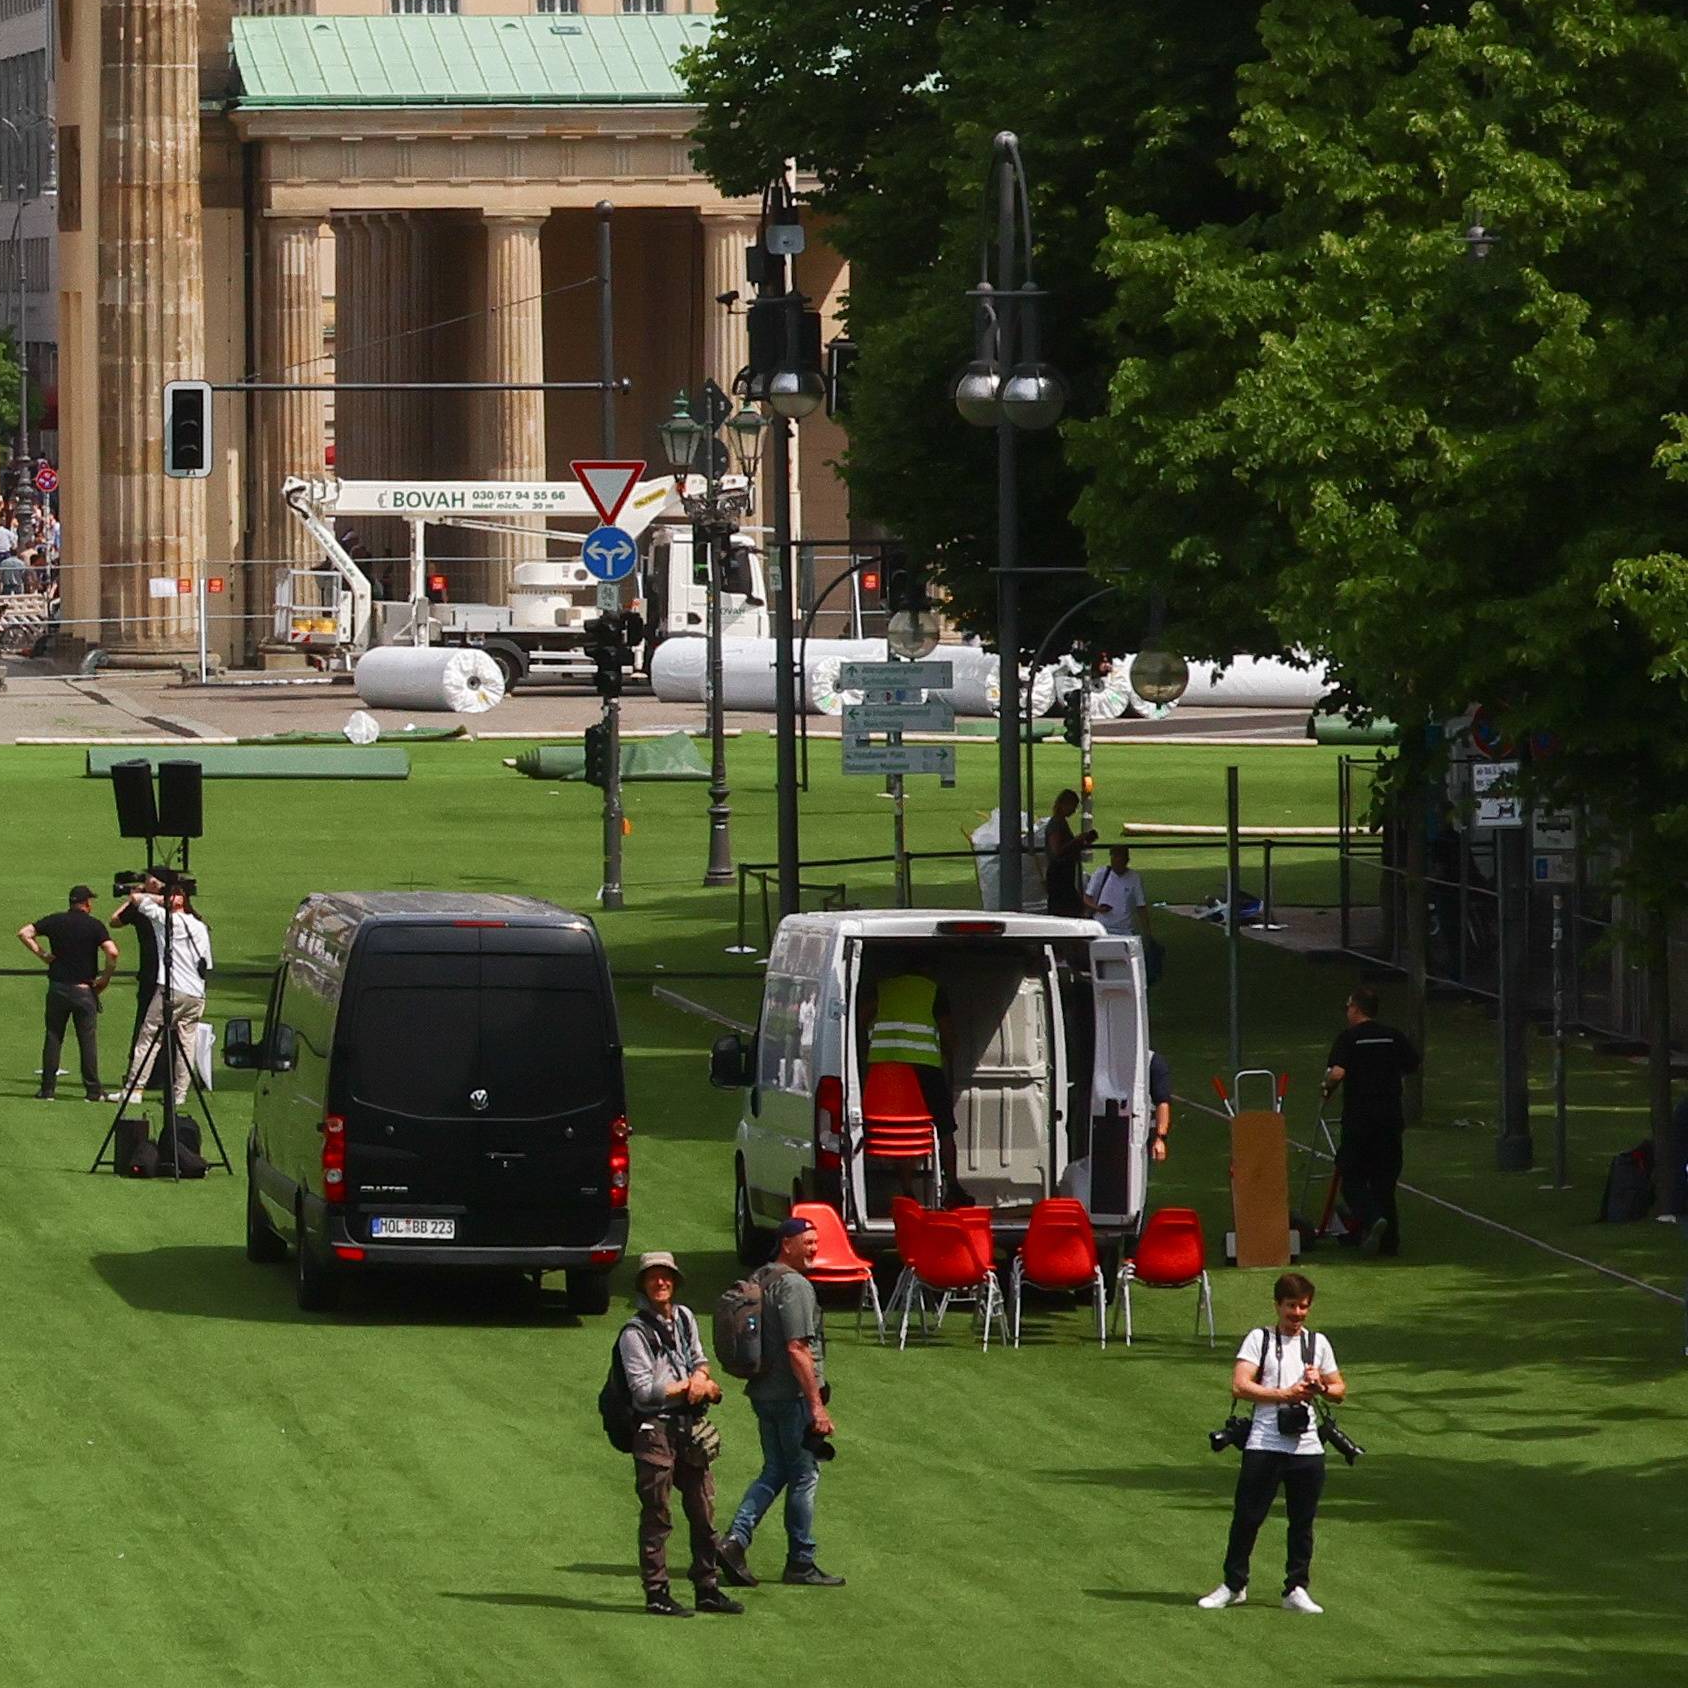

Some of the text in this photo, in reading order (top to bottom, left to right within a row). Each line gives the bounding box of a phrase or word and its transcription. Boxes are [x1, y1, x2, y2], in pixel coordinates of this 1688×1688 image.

[392, 491, 466, 509] BOVAH
[515, 491, 530, 500] 94
[533, 491, 548, 500] 55
[431, 1221, 454, 1235] 223
